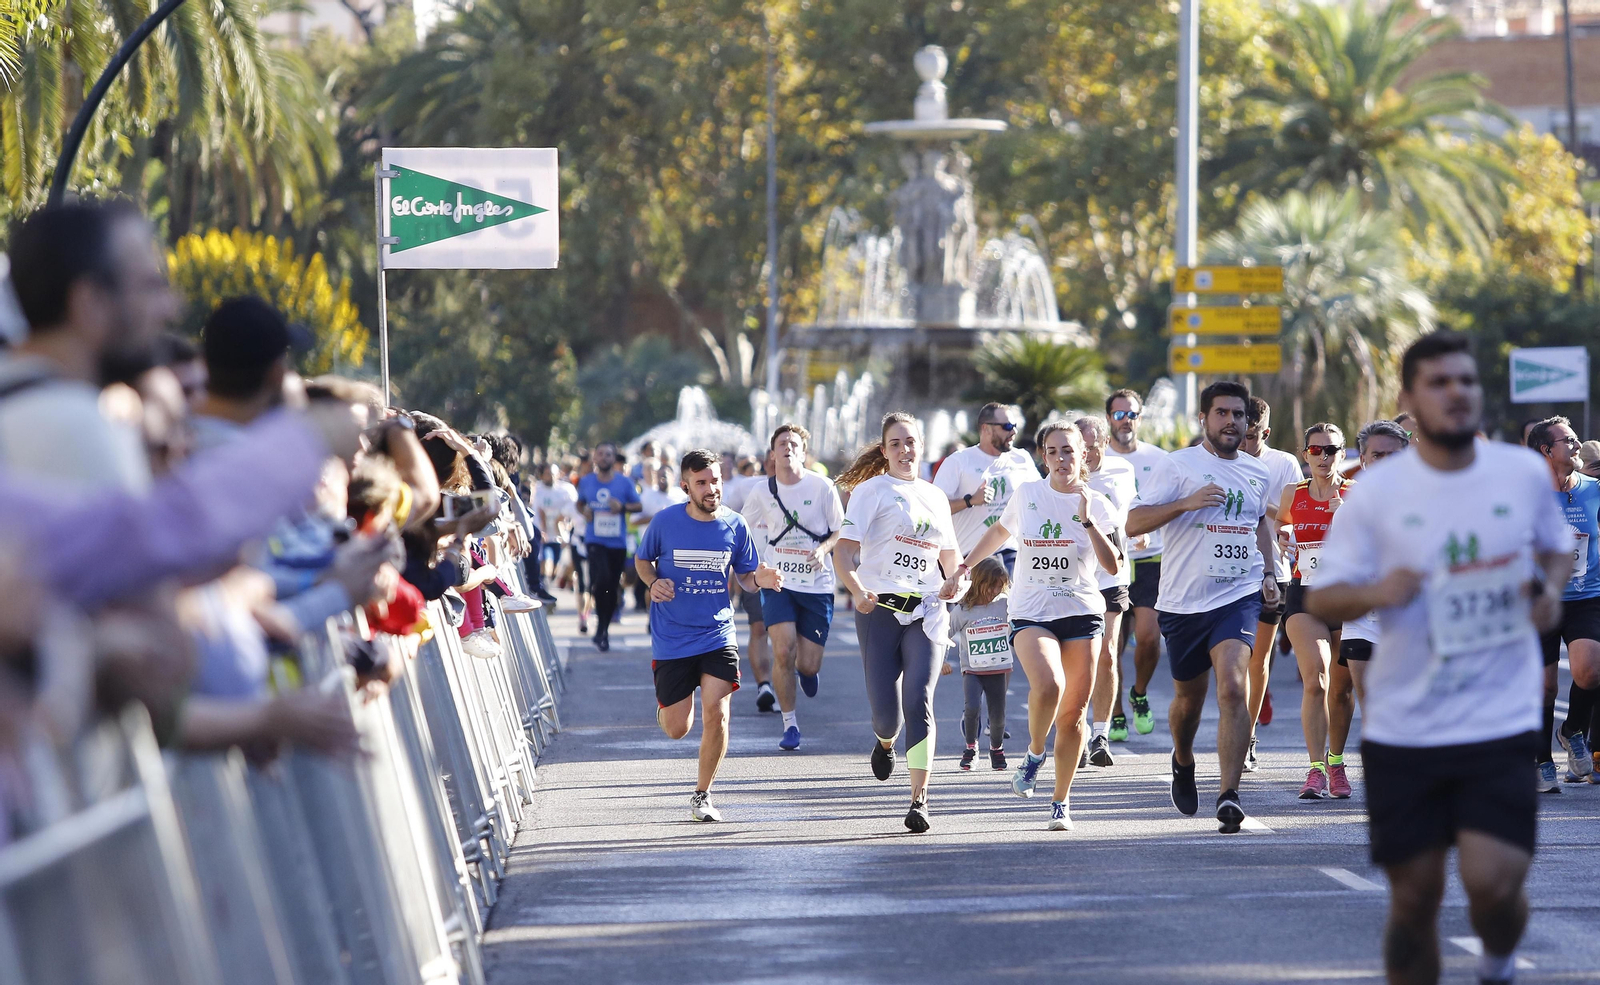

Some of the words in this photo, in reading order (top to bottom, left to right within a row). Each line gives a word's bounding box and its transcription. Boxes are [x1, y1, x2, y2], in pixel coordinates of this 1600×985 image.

[391, 196, 411, 216] El
[411, 197, 452, 216] Corte
[1206, 525, 1217, 533] 41
[1023, 539, 1032, 547] 41
[1213, 544, 1249, 560] 3338
[776, 561, 812, 574] 18289
[893, 552, 927, 572] 2939
[1032, 556, 1069, 570] 2940
[971, 639, 1007, 655] 24149
